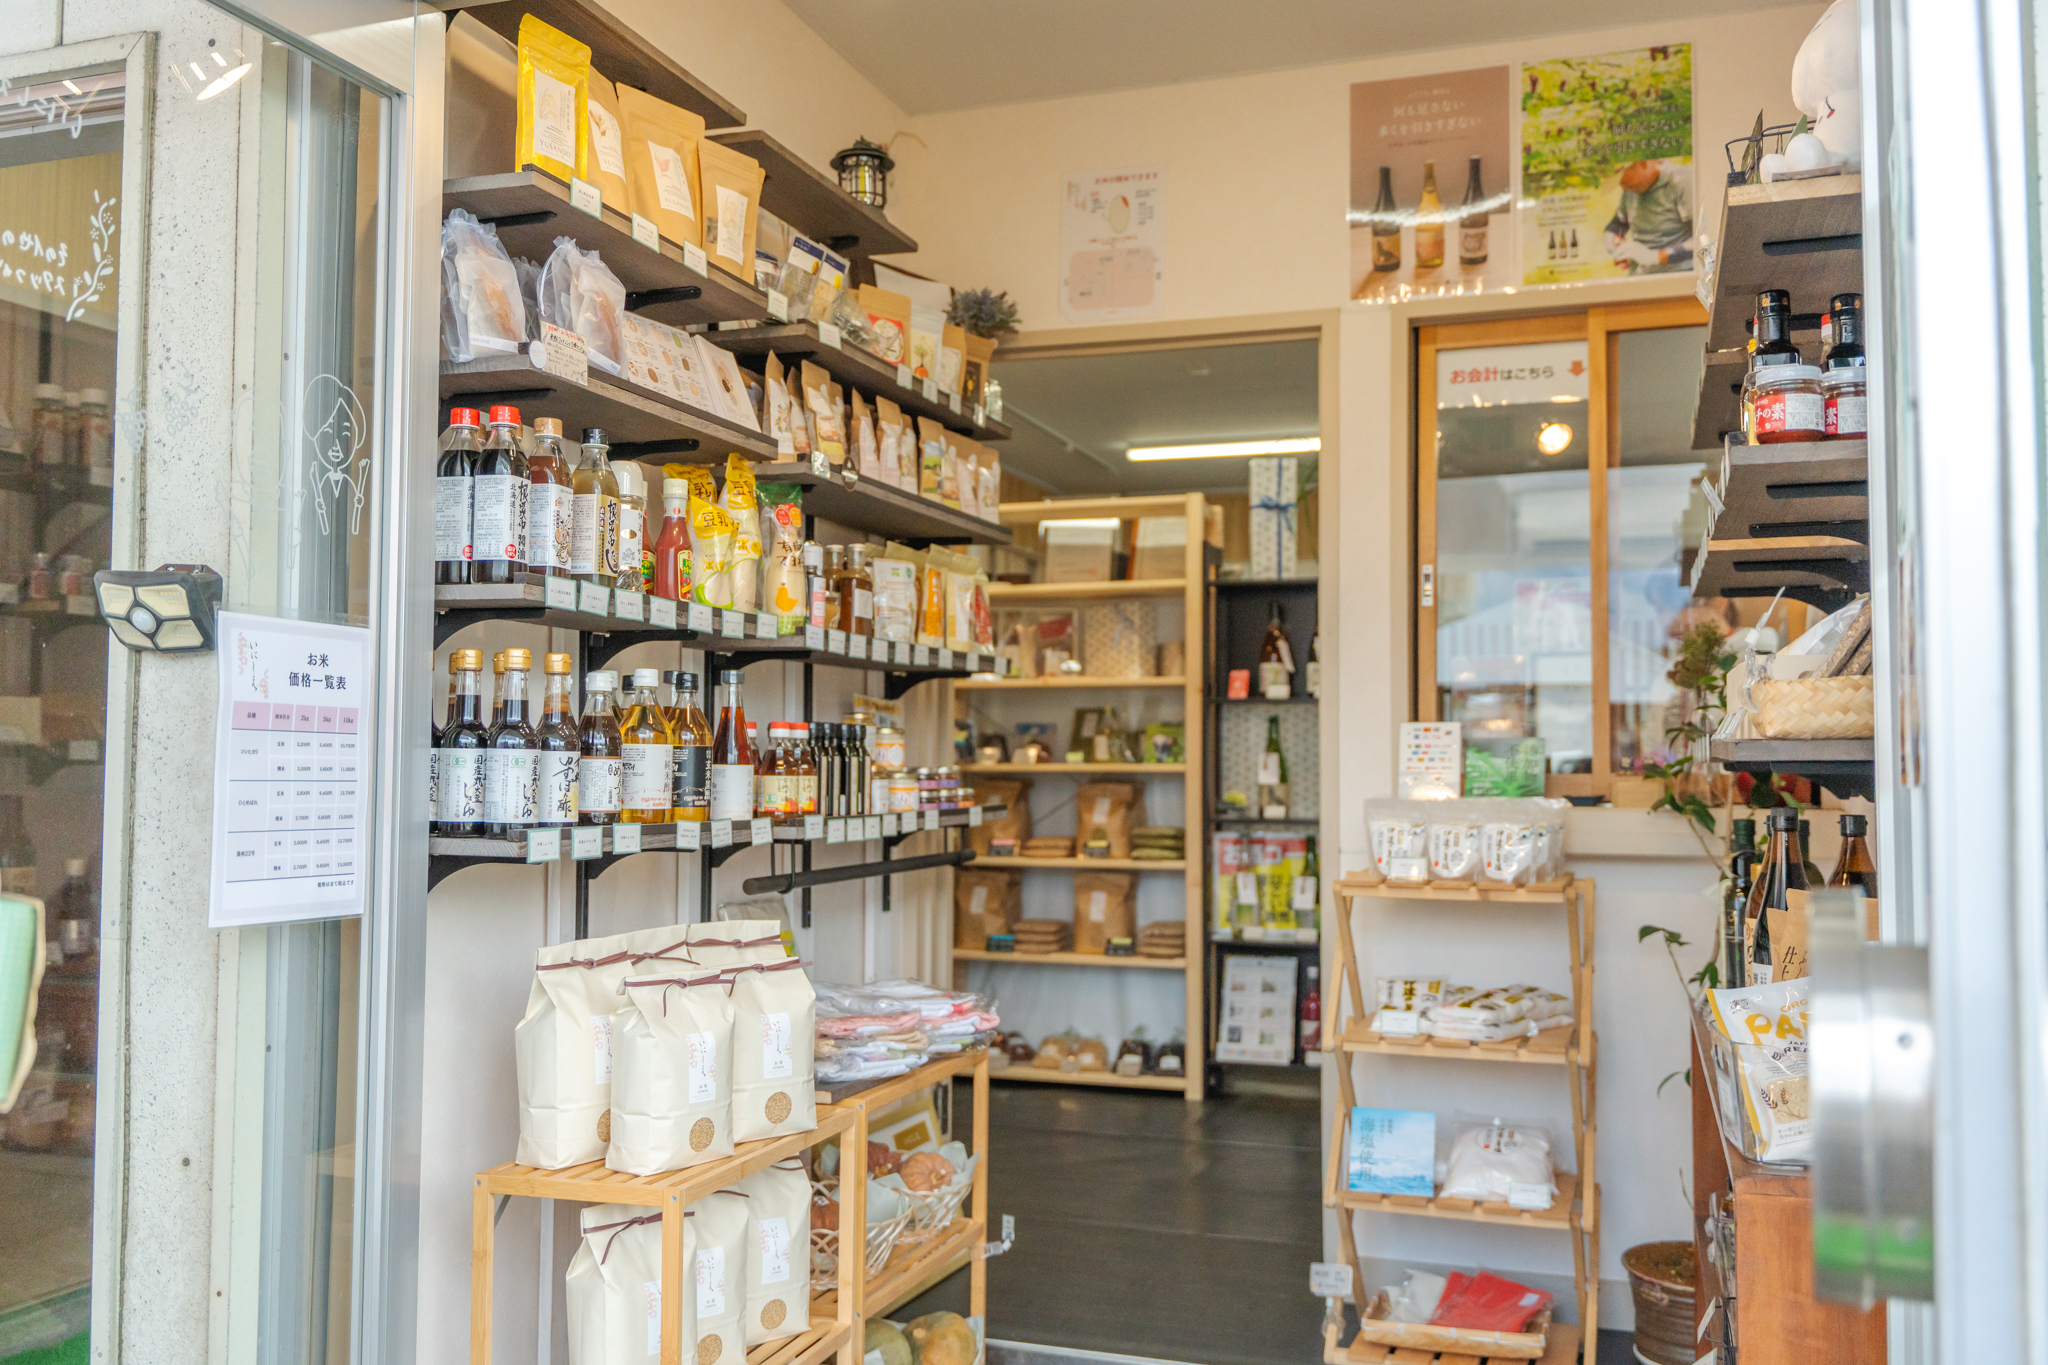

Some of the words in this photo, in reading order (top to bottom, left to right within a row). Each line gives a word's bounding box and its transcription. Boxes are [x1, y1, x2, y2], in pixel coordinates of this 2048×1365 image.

[539, 139, 571, 158] YUSANDO
[1449, 366, 1555, 384] お会計はこちら
[1825, 407, 1837, 425] 素
[510, 483, 518, 509] 北海道
[307, 653, 329, 668] お米
[289, 672, 346, 690] 価格一覧表
[472, 754, 483, 804] 国産丸大豆
[530, 755, 539, 805] 国産丸大豆
[553, 757, 574, 818] ゆずぽん酢
[317, 879, 354, 888] 価格は全て税込です
[1359, 1117, 1375, 1181] 海塩使用
